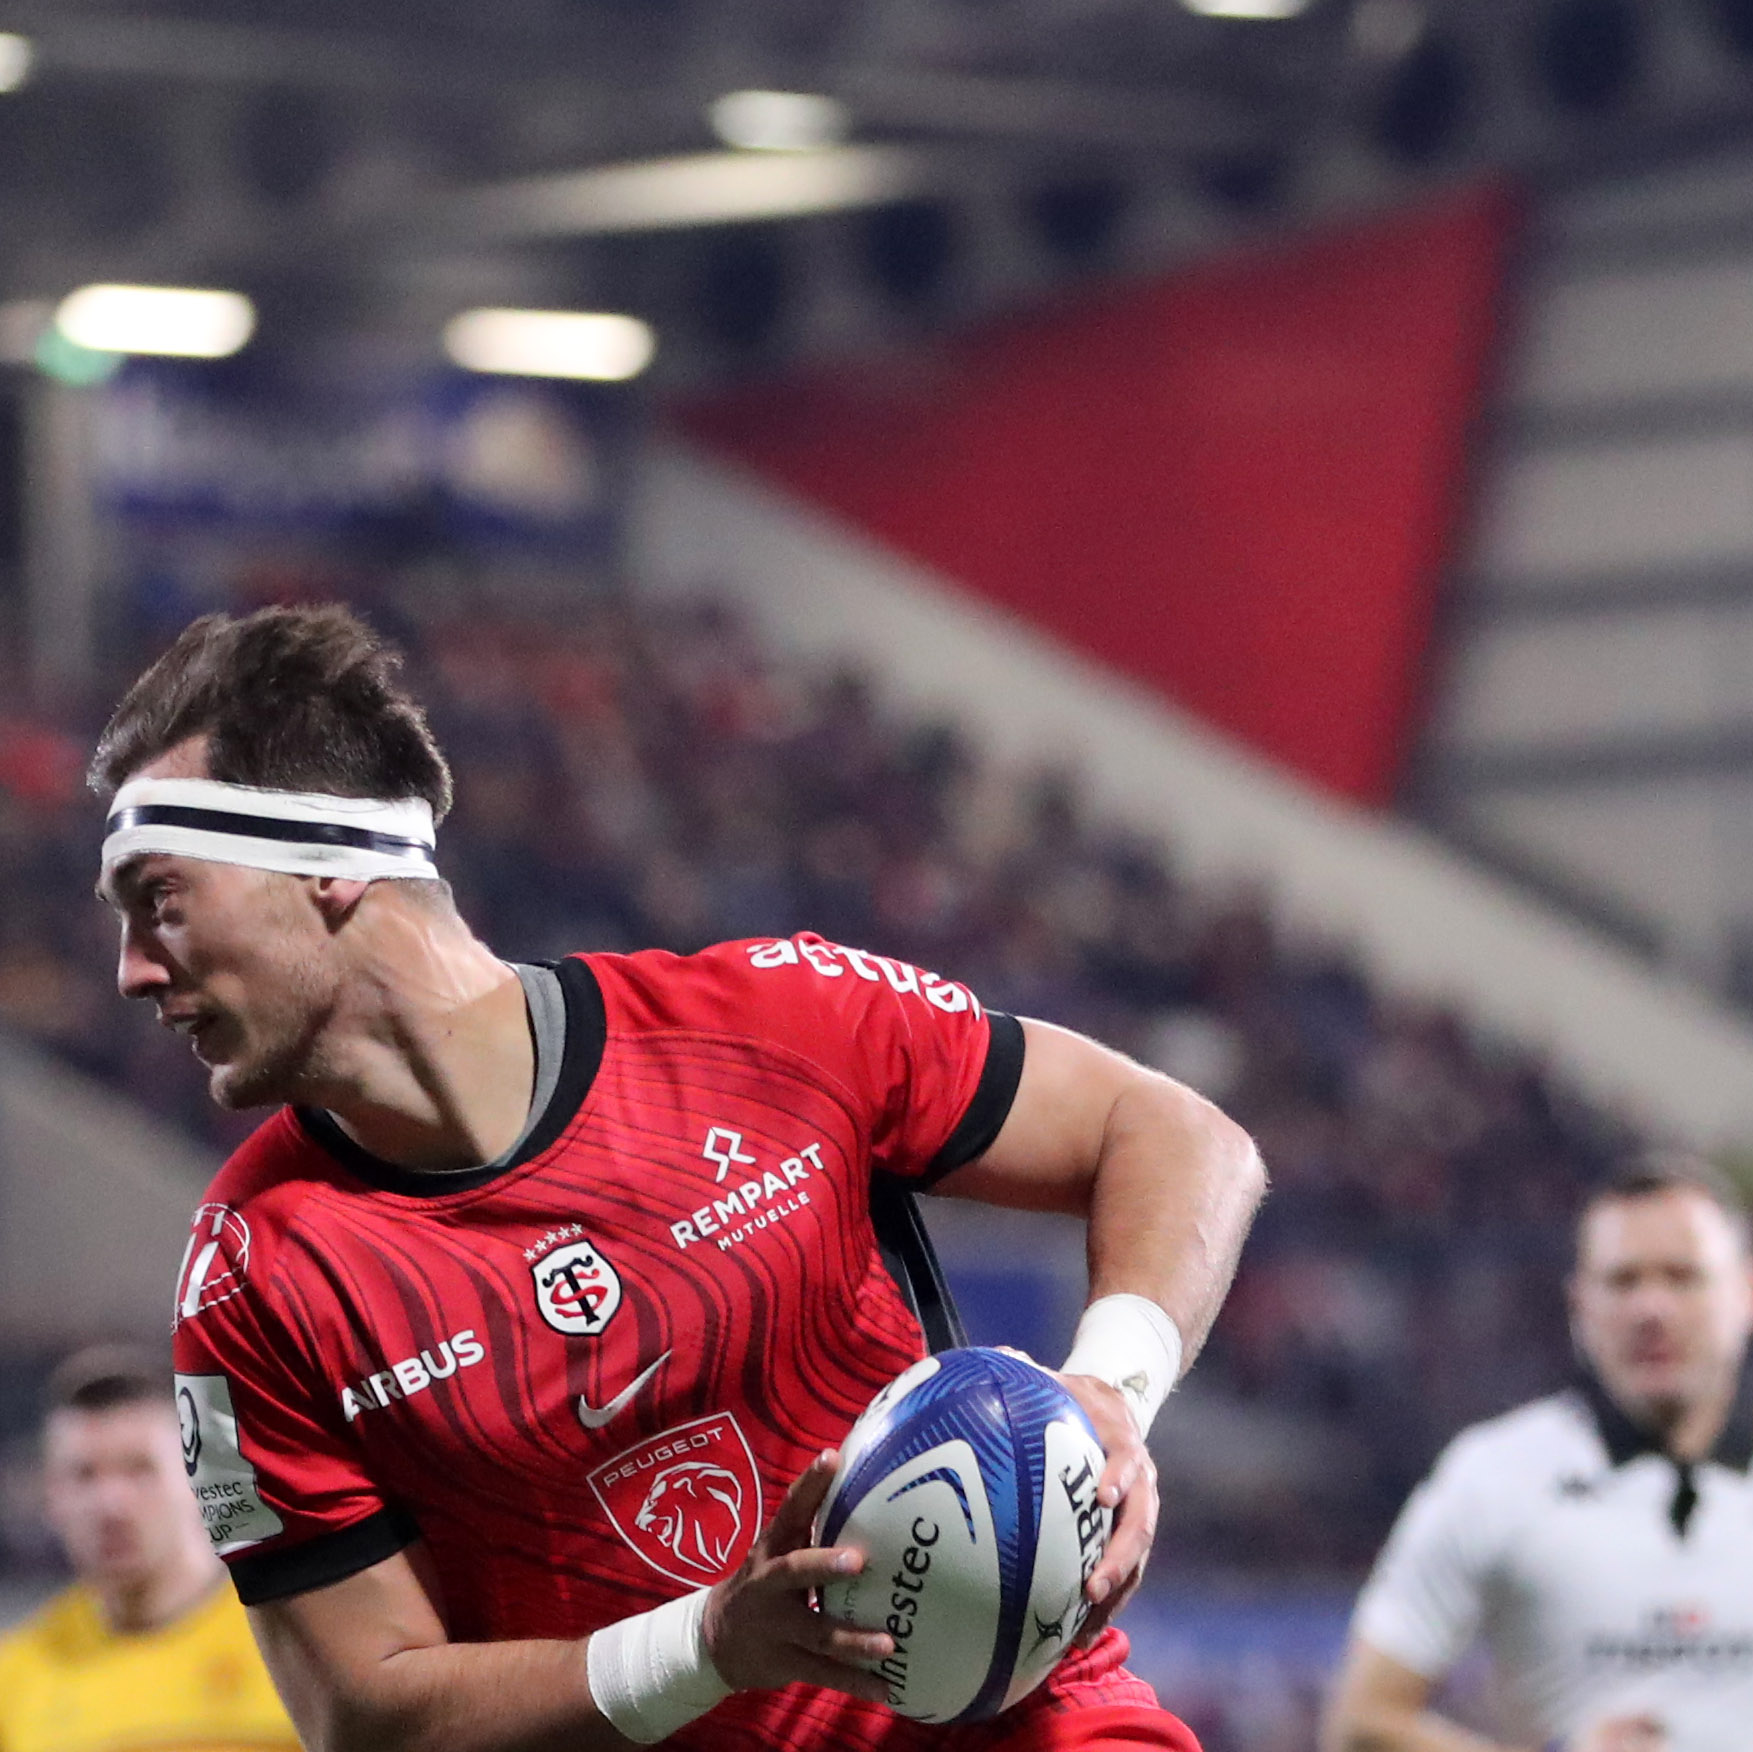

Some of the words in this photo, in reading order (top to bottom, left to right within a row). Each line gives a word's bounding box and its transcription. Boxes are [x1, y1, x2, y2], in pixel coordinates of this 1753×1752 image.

[670, 1142, 825, 1249] REMPART
[717, 1191, 811, 1252] MUTUELLE
[341, 1329, 485, 1422] AIRBUS
[603, 1426, 724, 1488] PEUGEOT
[191, 1481, 244, 1501] vestec
[201, 1498, 256, 1523] MPIONS
[209, 1523, 233, 1543] UP
